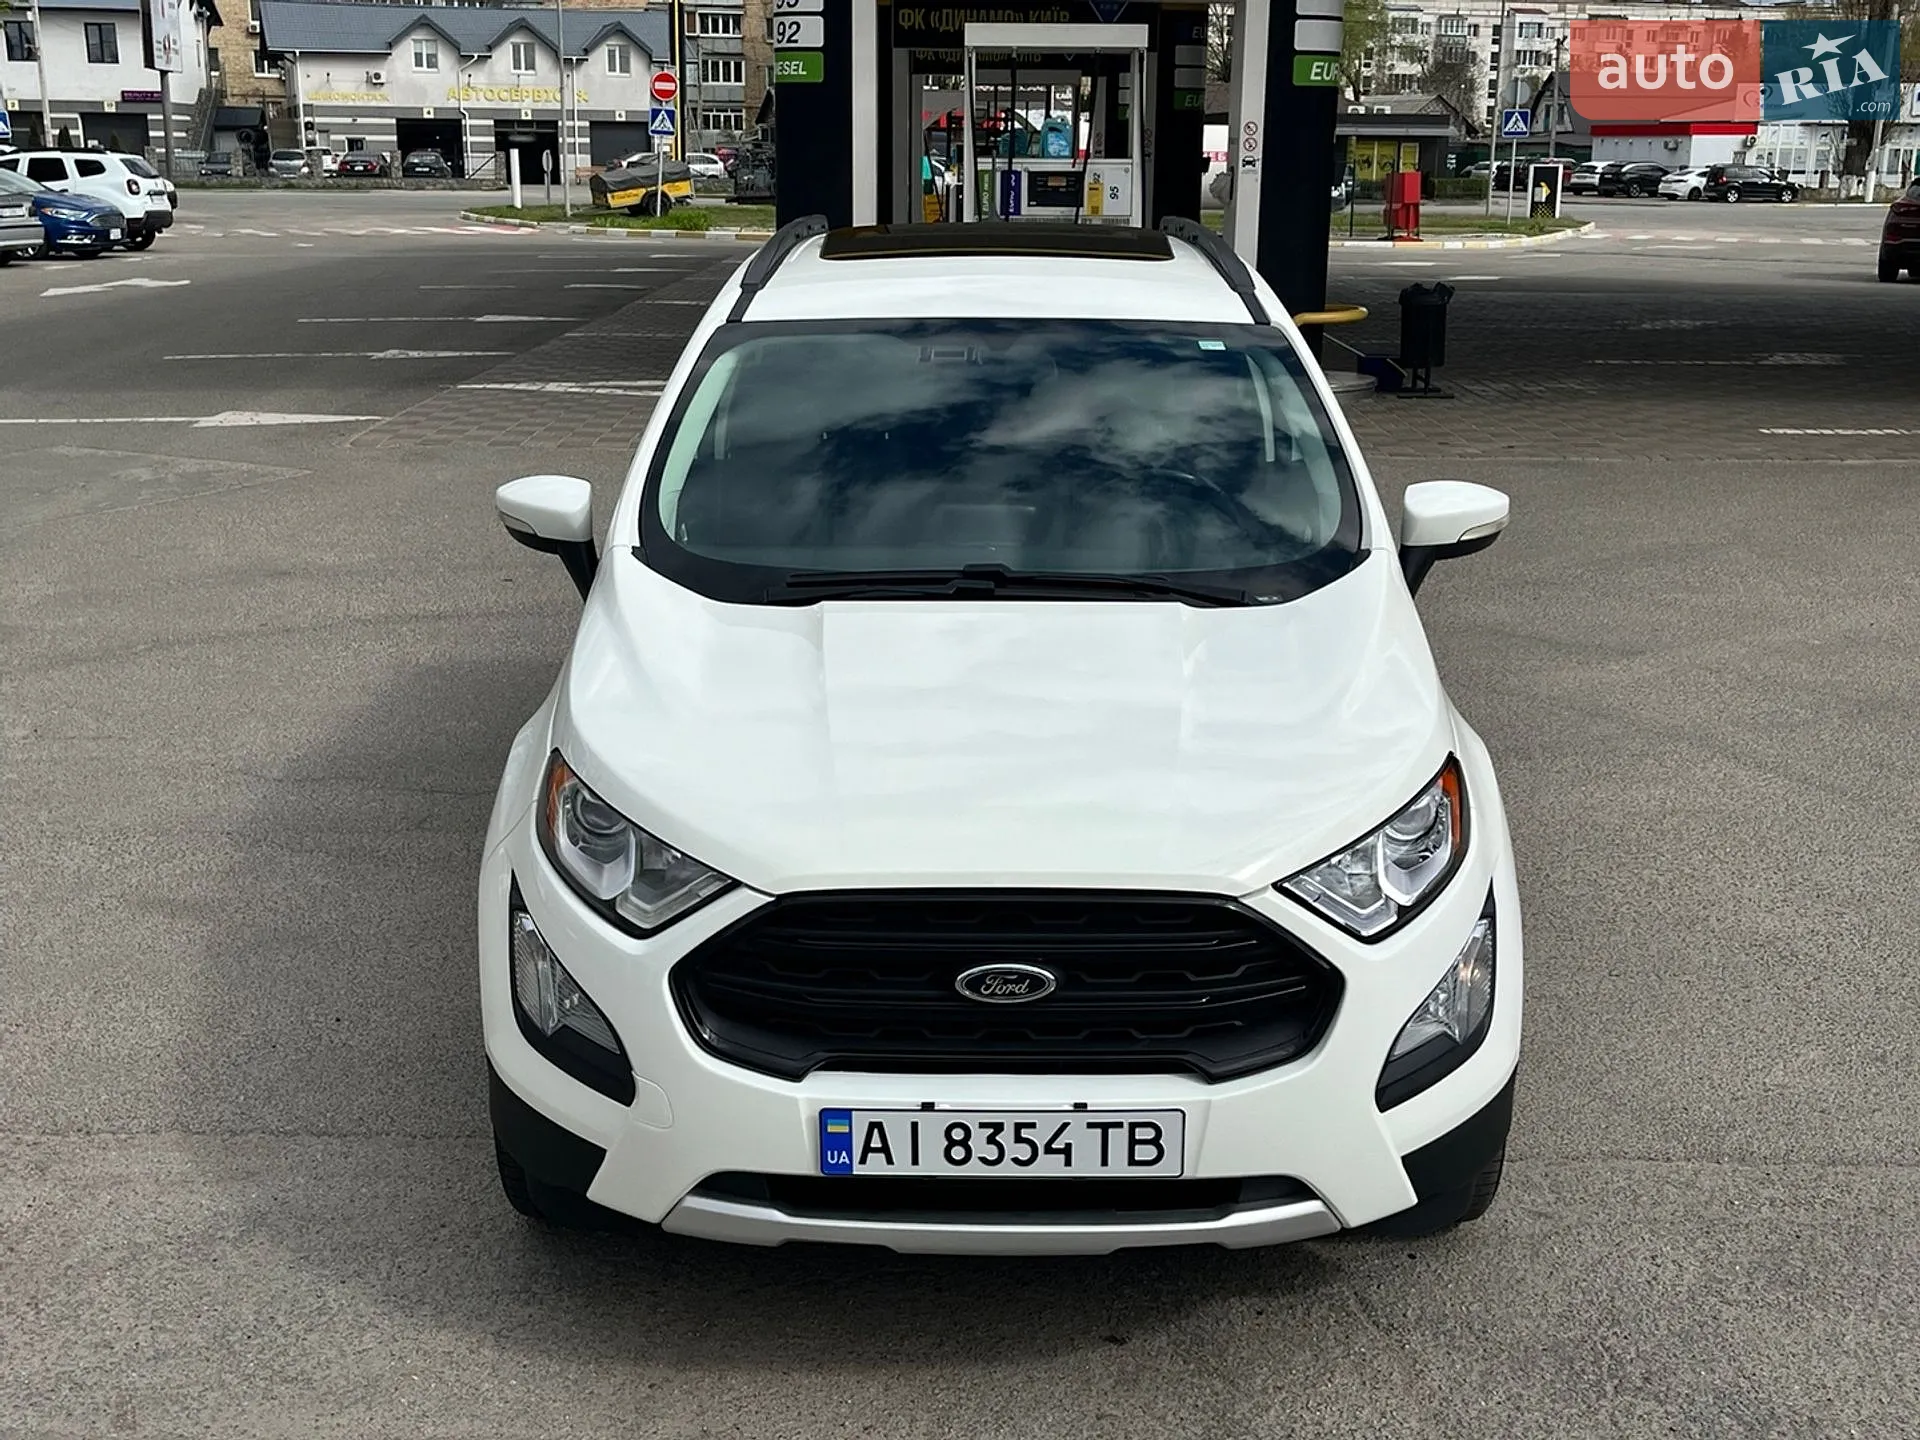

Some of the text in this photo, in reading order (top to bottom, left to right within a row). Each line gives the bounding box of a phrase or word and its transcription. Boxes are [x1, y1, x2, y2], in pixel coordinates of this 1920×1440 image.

[898, 8, 926, 31] ФК
[777, 21, 801, 44] 92
[1109, 186, 1119, 200] 95
[980, 975, 1030, 995] Ford
[857, 1120, 1166, 1168] AI 8354 TB
[826, 1149, 851, 1166] UA
